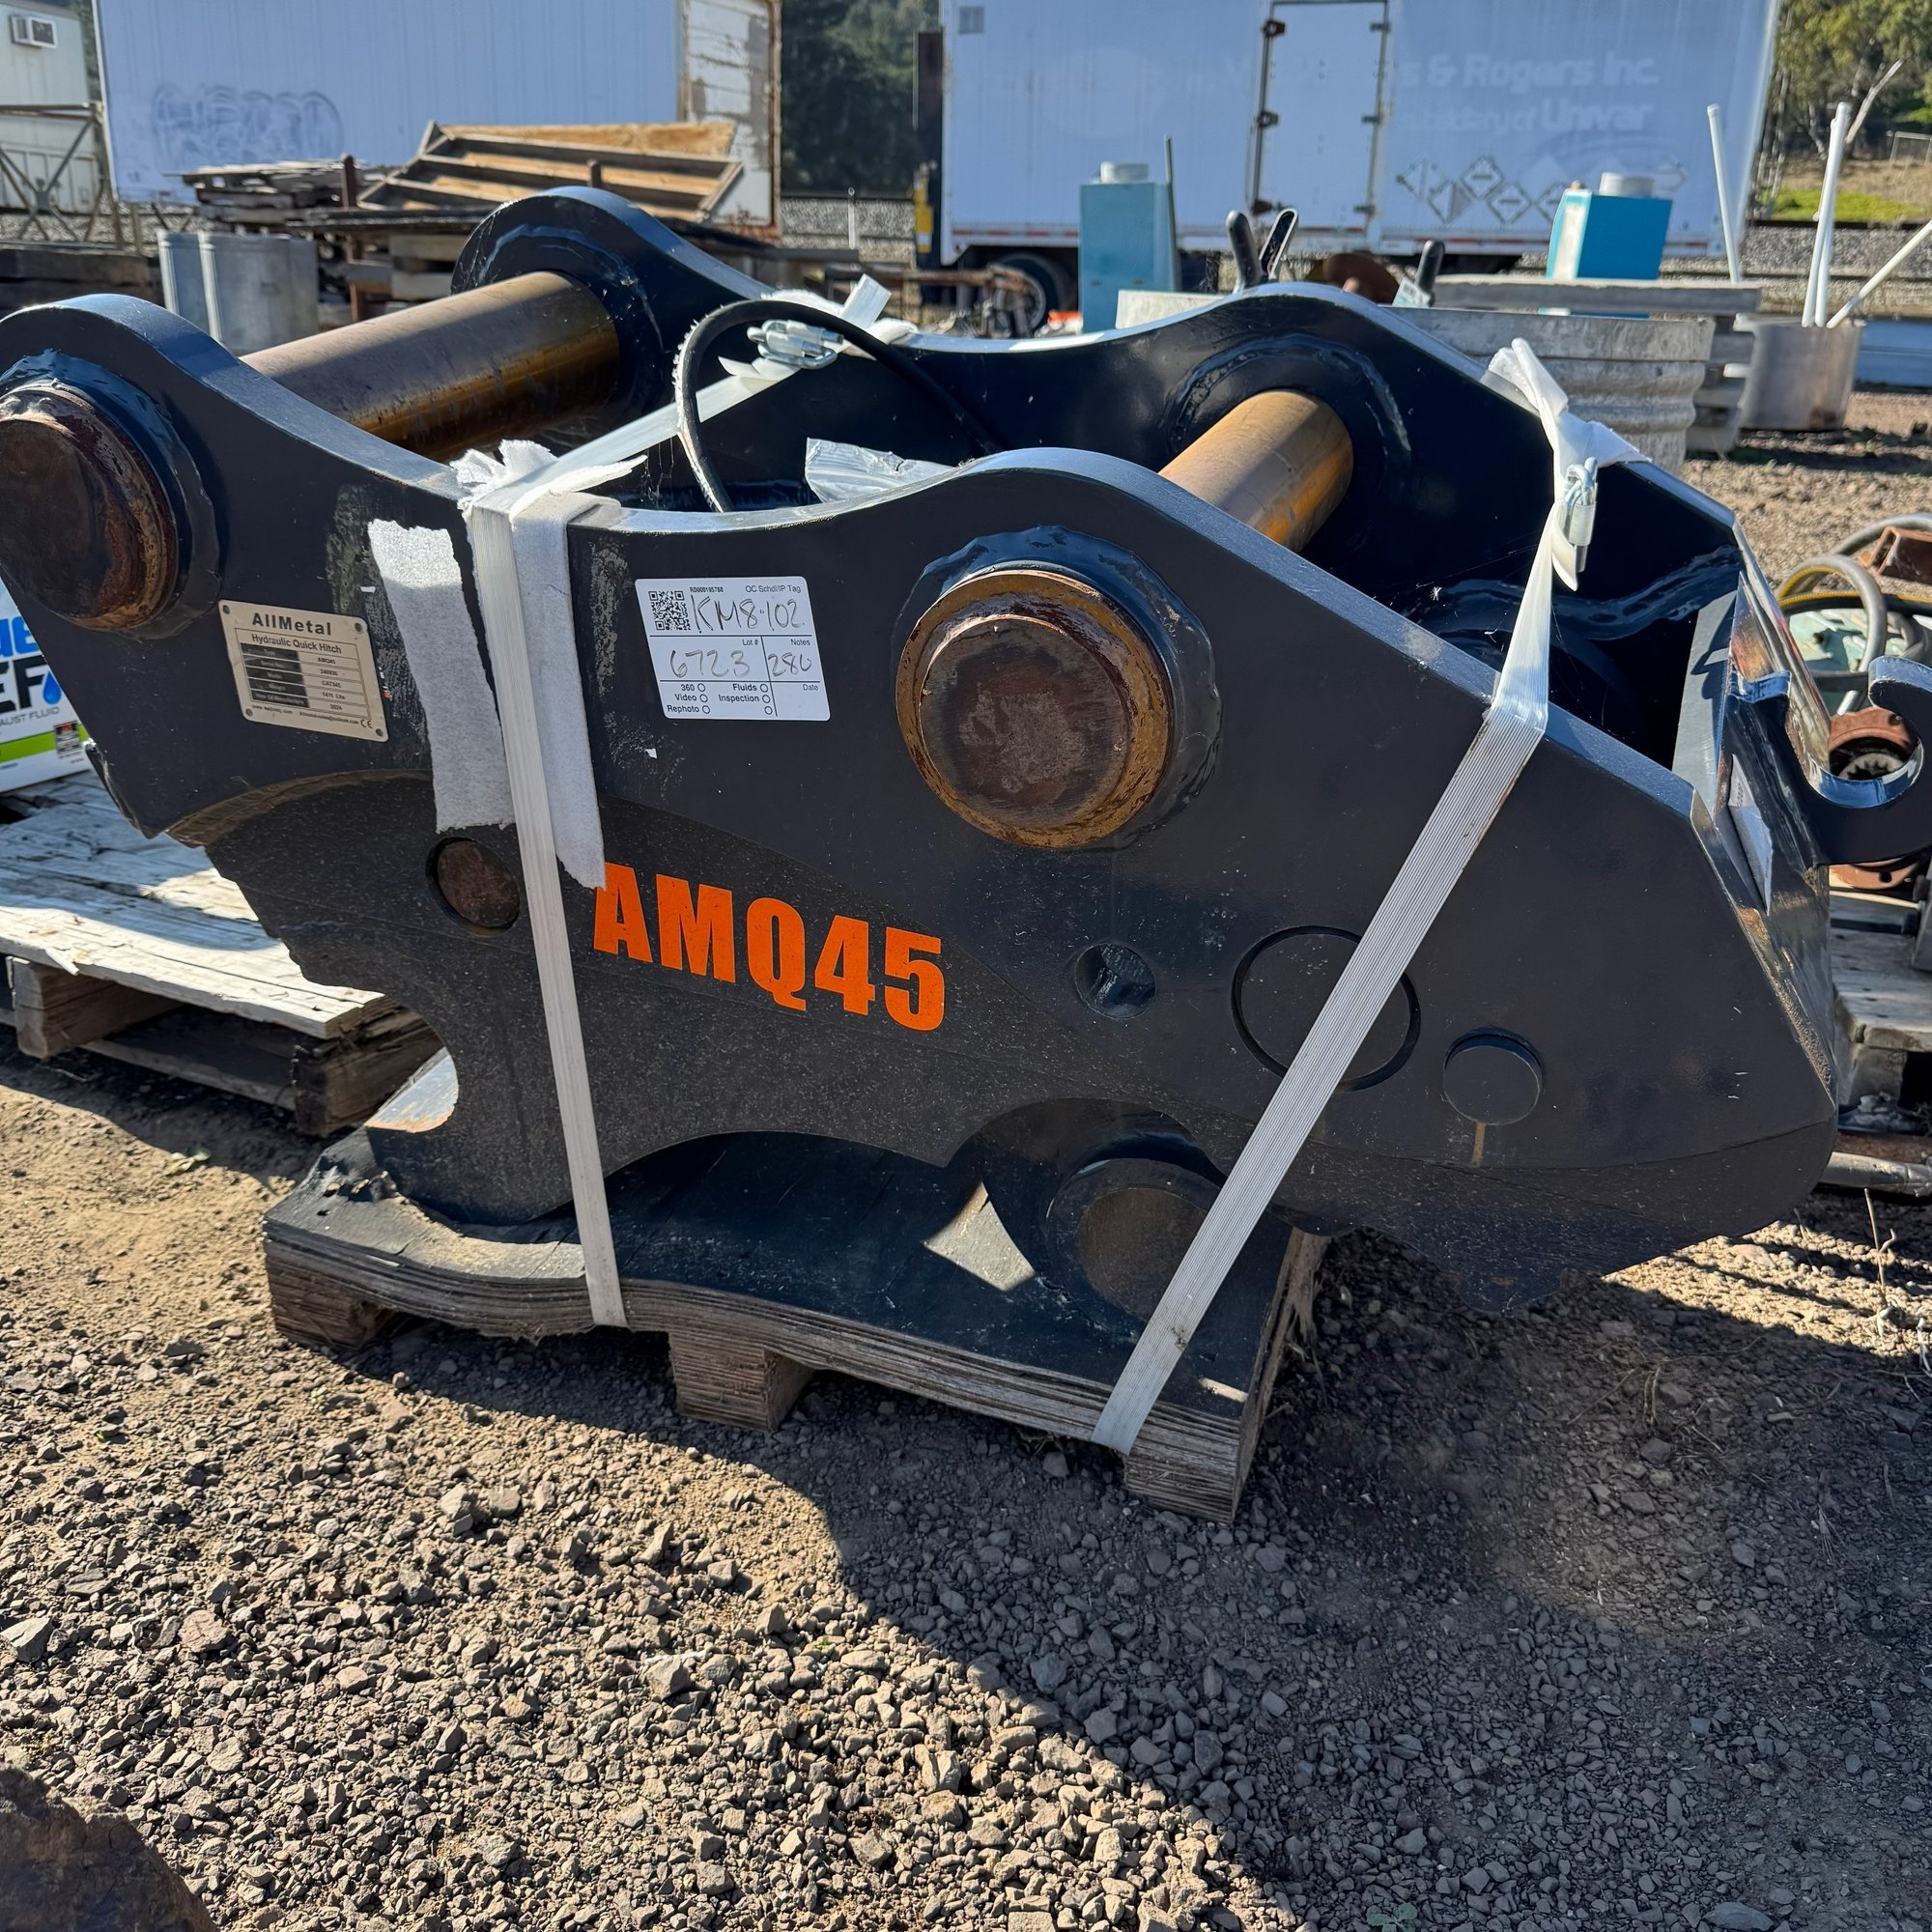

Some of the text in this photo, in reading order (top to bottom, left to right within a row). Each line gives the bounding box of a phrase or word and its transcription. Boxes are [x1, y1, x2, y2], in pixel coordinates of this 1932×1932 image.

[1428, 53, 1458, 87] &
[1463, 52, 1595, 94] Rogers
[786, 585, 802, 594] Tag
[252, 612, 332, 636] AllMetal
[251, 634, 342, 655] Hydraulic Quick Hitch
[669, 650, 751, 678] 6723
[667, 704, 700, 714] Rephoto
[718, 695, 760, 703] Inspection
[29, 706, 60, 722] FLUID
[593, 862, 946, 1032] AMQ45
